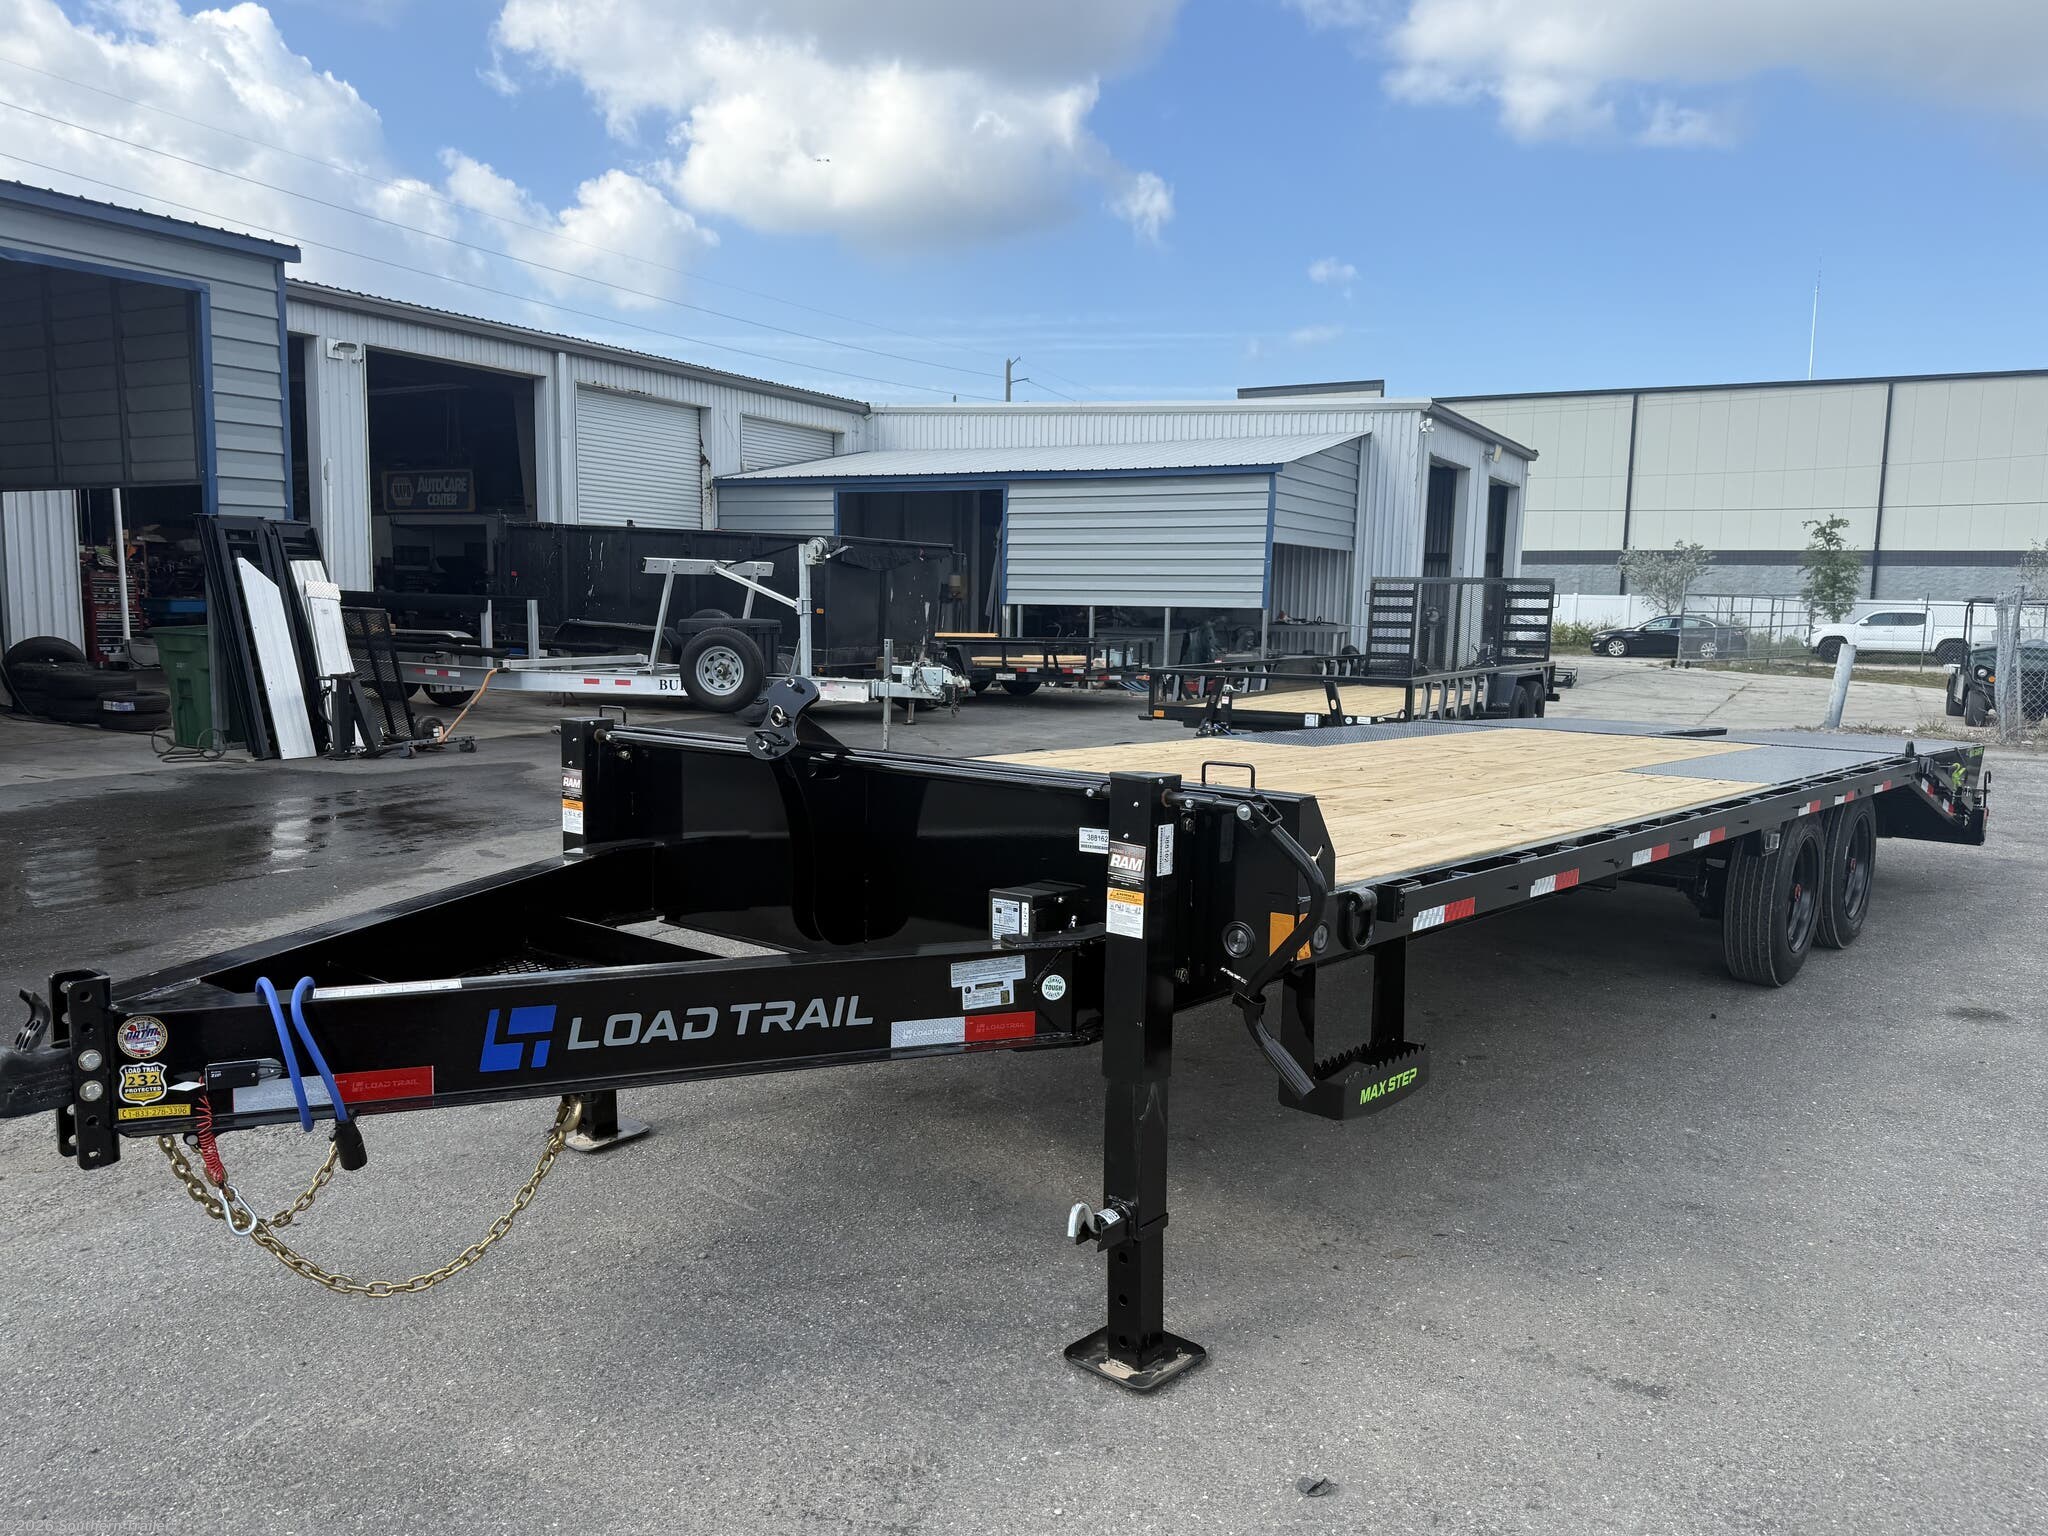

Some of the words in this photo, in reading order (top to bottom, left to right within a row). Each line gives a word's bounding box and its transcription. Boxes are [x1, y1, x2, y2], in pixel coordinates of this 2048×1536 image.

[427, 493, 457, 505] CENTER
[563, 776, 581, 789] RAM
[1110, 853, 1143, 872] RAM
[1045, 982, 1063, 992] TOUGH
[567, 1006, 719, 1051] LOAD
[730, 995, 874, 1036] TRAIL
[128, 1074, 158, 1086] 232
[365, 1080, 392, 1091] LOAD
[392, 1078, 420, 1087] TRAIL
[1360, 1080, 1387, 1105] MAX
[1387, 1067, 1418, 1093] STEP
[125, 1086, 162, 1094] PROTECTED
